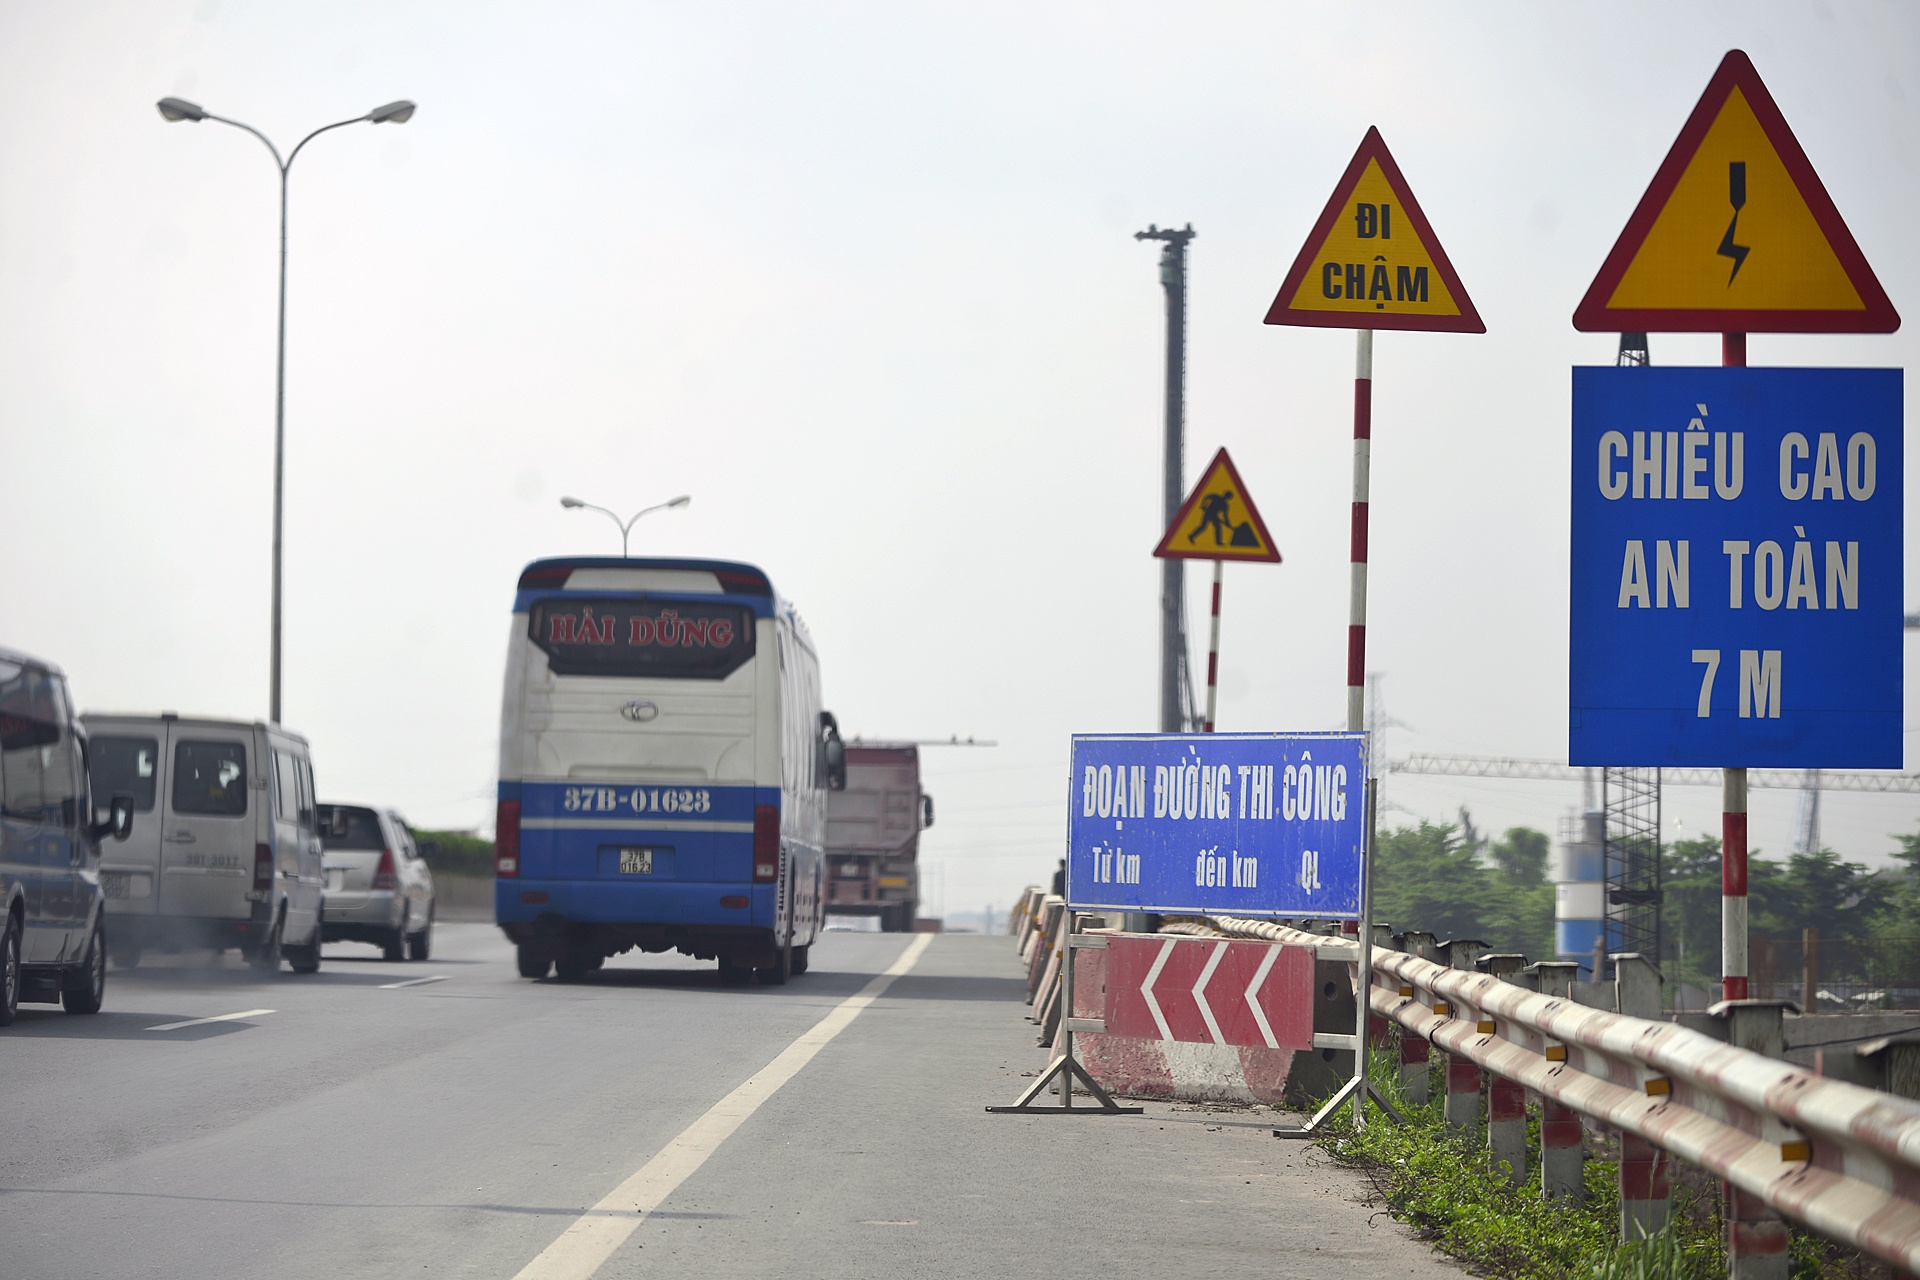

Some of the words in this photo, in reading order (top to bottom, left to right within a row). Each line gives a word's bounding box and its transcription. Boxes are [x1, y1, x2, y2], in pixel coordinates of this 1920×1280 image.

[1355, 203, 1391, 240] ĐI
[1322, 255, 1429, 310] CHẬM
[1598, 403, 1744, 501] CHIỀU
[1779, 431, 1877, 501] CAO
[1617, 540, 1690, 609] AN
[1723, 525, 1859, 610] TOÀN
[550, 605, 616, 646] HẢI
[629, 609, 734, 648] DŨNG
[1691, 649, 1721, 718] 7
[1739, 649, 1782, 719] M
[564, 786, 711, 814] 37B-01623
[1083, 764, 1146, 831] ĐOẠN
[1153, 745, 1231, 820] ĐƯỜNG
[1238, 765, 1274, 820] THI
[1282, 750, 1347, 822] CÔNG
[627, 851, 646, 863] 37B
[1092, 840, 1113, 884] Từ
[1116, 847, 1141, 885] km
[1195, 845, 1227, 888] đến
[1232, 850, 1258, 888] km
[1301, 850, 1321, 896] QL
